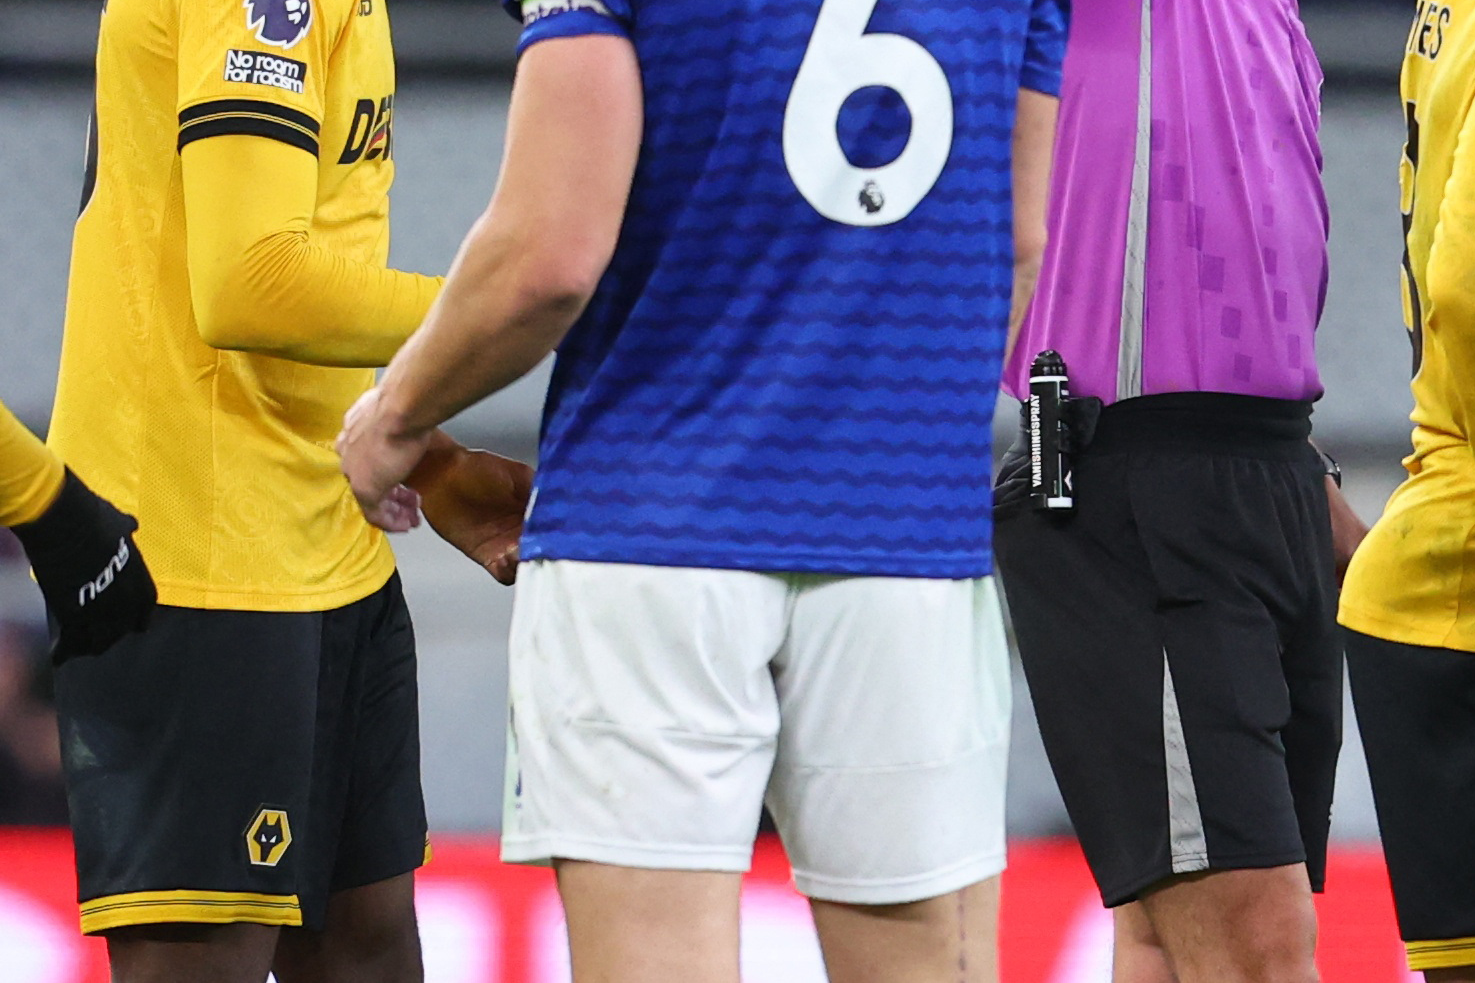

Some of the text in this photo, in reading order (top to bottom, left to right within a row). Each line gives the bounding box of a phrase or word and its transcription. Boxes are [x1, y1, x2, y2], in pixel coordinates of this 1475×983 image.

[223, 65, 252, 83] for
[226, 49, 300, 78] No room
